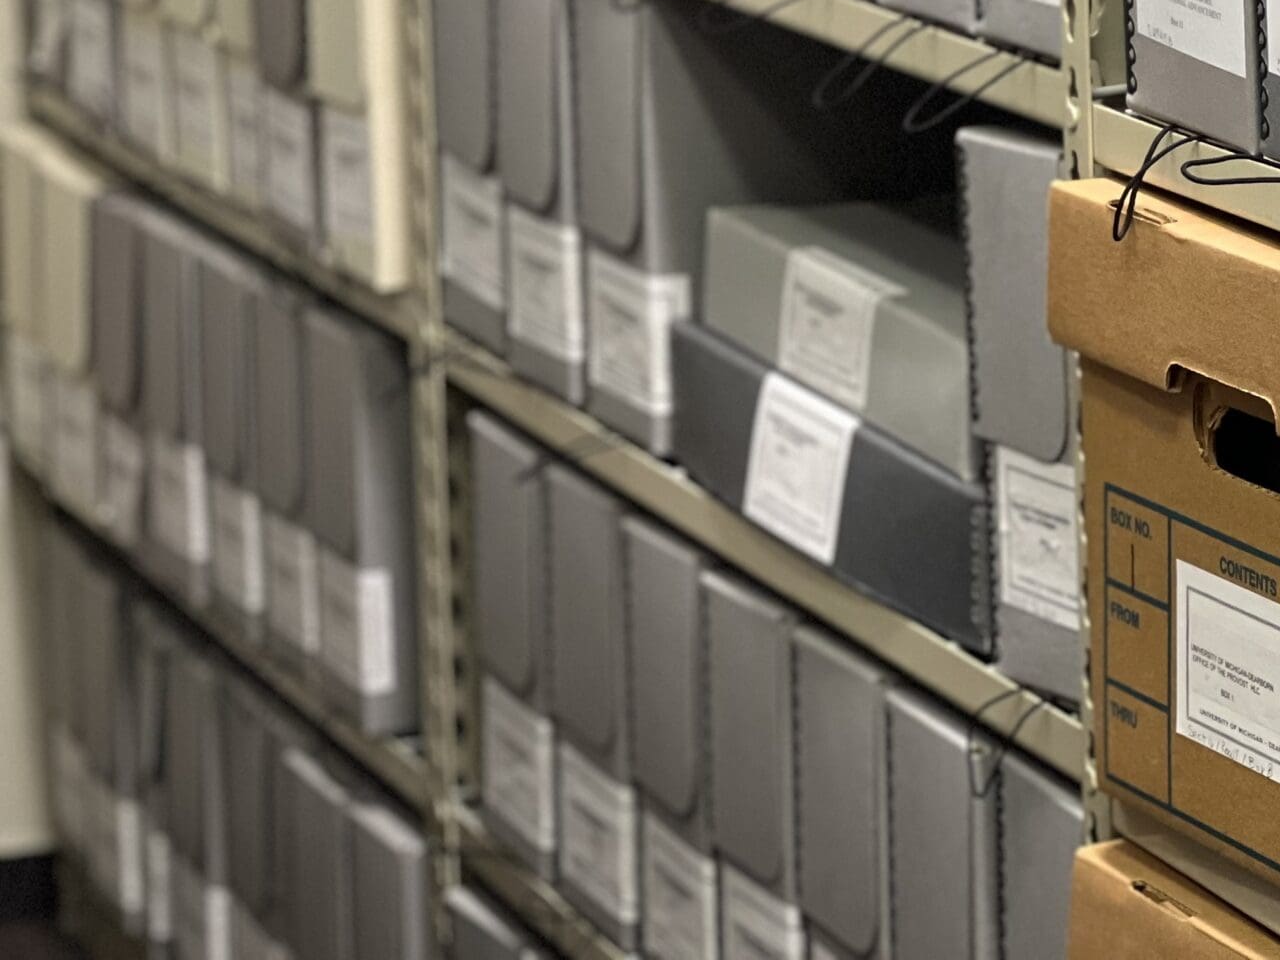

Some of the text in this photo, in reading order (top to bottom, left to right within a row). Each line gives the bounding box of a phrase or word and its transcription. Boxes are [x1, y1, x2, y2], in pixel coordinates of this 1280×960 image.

[1111, 507, 1153, 541] BOX NO.
[1219, 556, 1277, 597] CONTENTS
[1111, 601, 1140, 629] FROM
[1191, 643, 1217, 661] UNIVERSITY
[1217, 655, 1223, 666] OF
[1192, 654, 1208, 669] OFFICE
[1210, 662, 1216, 672] OF
[1217, 666, 1226, 678] THE
[1110, 701, 1138, 729] THRU
[1200, 708, 1229, 726] UNIVERSITY
[1230, 722, 1237, 730] OF
[1238, 727, 1263, 744] MICHIGAN
